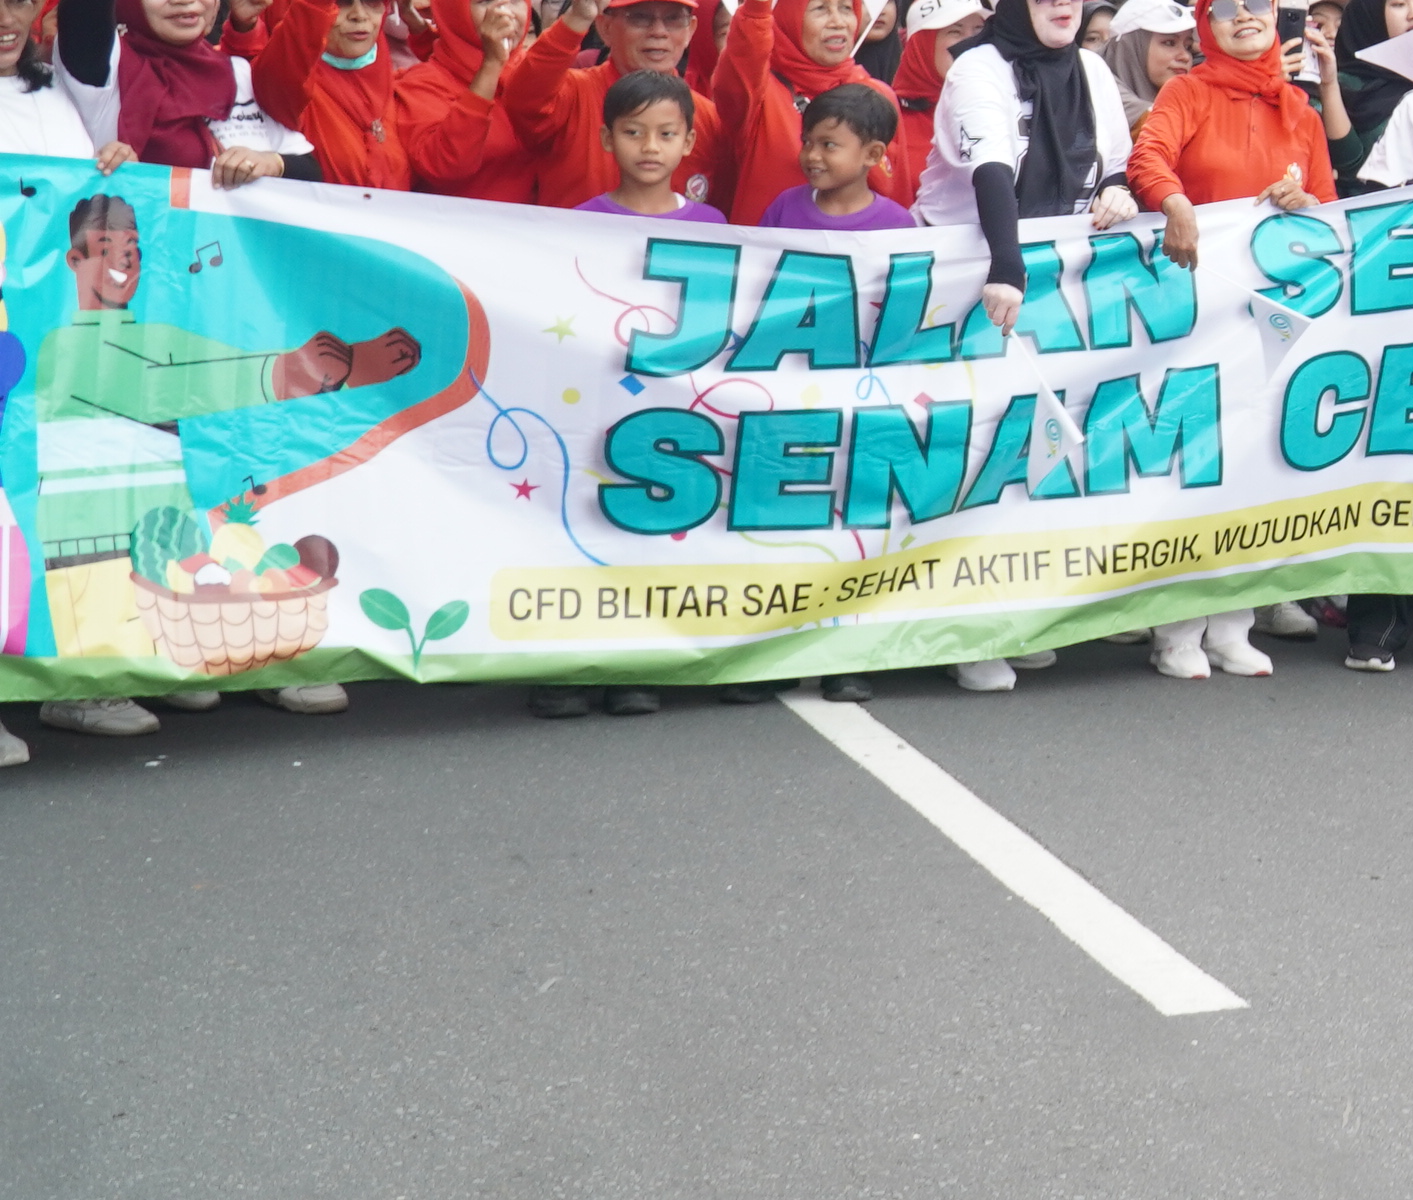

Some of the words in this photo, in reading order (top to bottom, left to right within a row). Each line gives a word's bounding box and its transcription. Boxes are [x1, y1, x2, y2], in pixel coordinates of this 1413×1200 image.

[625, 228, 1198, 377] JALAN
[598, 363, 1222, 535] SENAM
[509, 587, 582, 621] CFD
[598, 583, 728, 619] BLITAR
[742, 582, 814, 616] SAE
[835, 558, 942, 602] SEHAT
[952, 550, 1051, 589] AKTIF
[1064, 532, 1203, 578] ENERGIK,
[1213, 500, 1363, 564] WUJUDKAN
